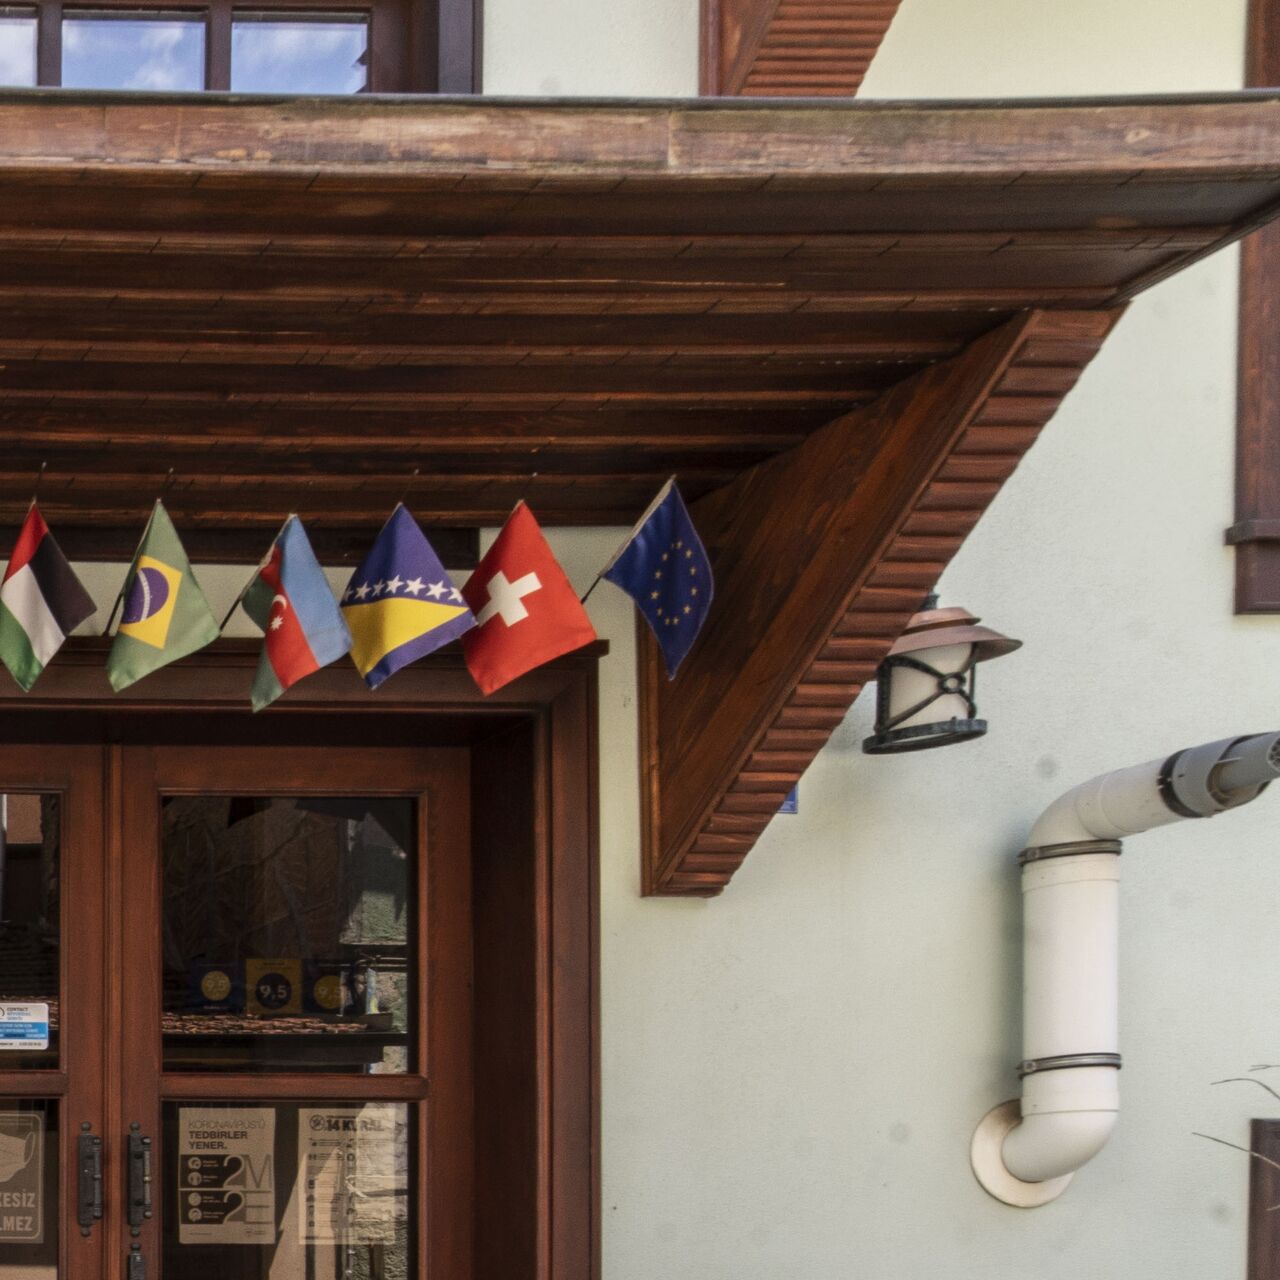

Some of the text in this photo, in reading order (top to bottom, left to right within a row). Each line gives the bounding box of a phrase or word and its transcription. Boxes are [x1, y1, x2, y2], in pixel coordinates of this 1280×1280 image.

[260, 984, 288, 999] 9,5
[327, 1119, 340, 1131] 14
[188, 1129, 248, 1139] TEDBİRLER
[188, 1141, 228, 1150] YENER.
